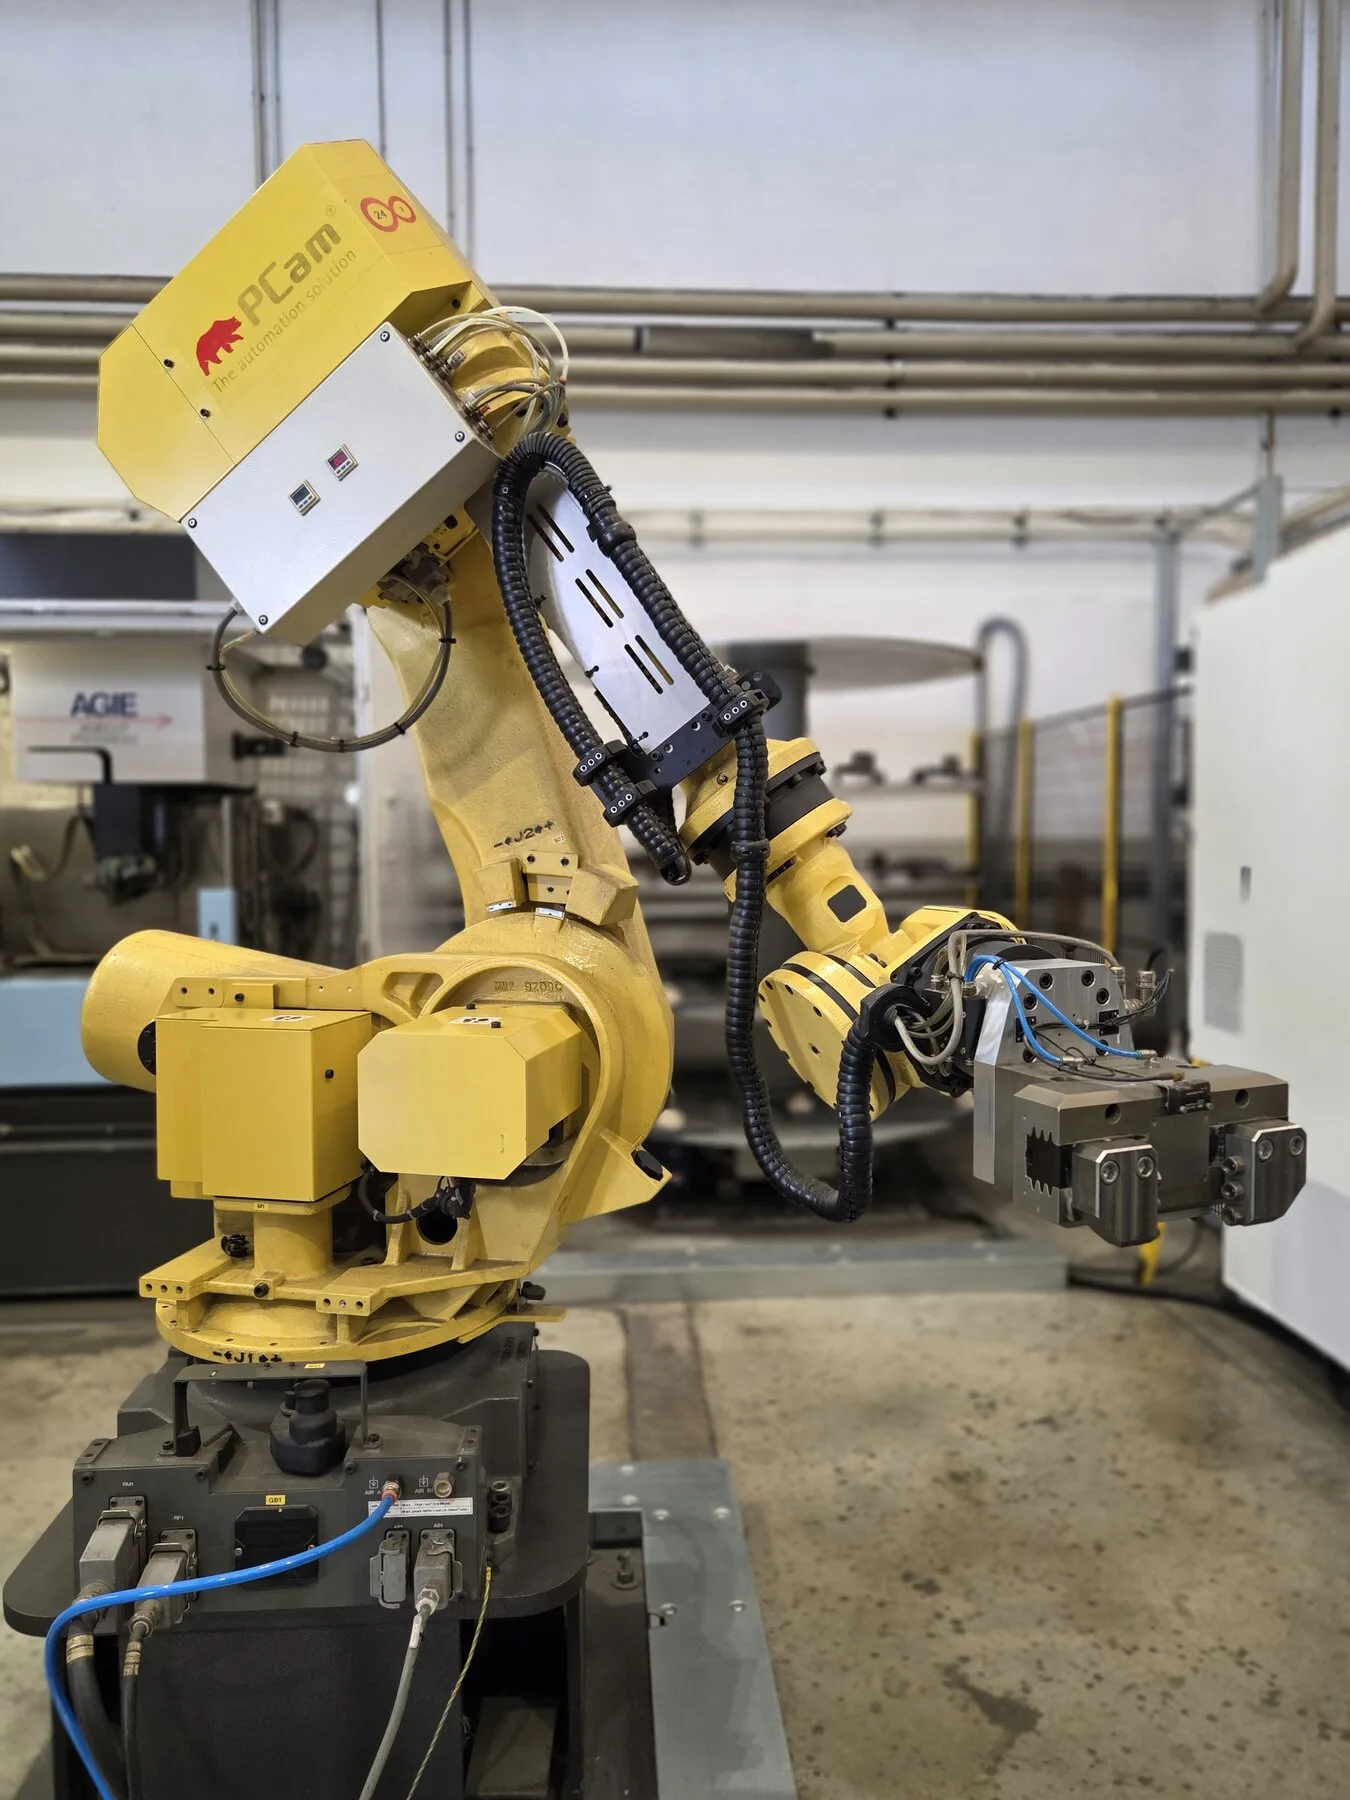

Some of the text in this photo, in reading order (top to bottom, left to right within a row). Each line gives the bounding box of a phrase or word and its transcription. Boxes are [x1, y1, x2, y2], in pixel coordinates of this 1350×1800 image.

[373, 210, 387, 220] 24
[237, 223, 342, 327] PCam
[211, 249, 357, 393] The automation solution
[69, 691, 138, 717] AGIE
